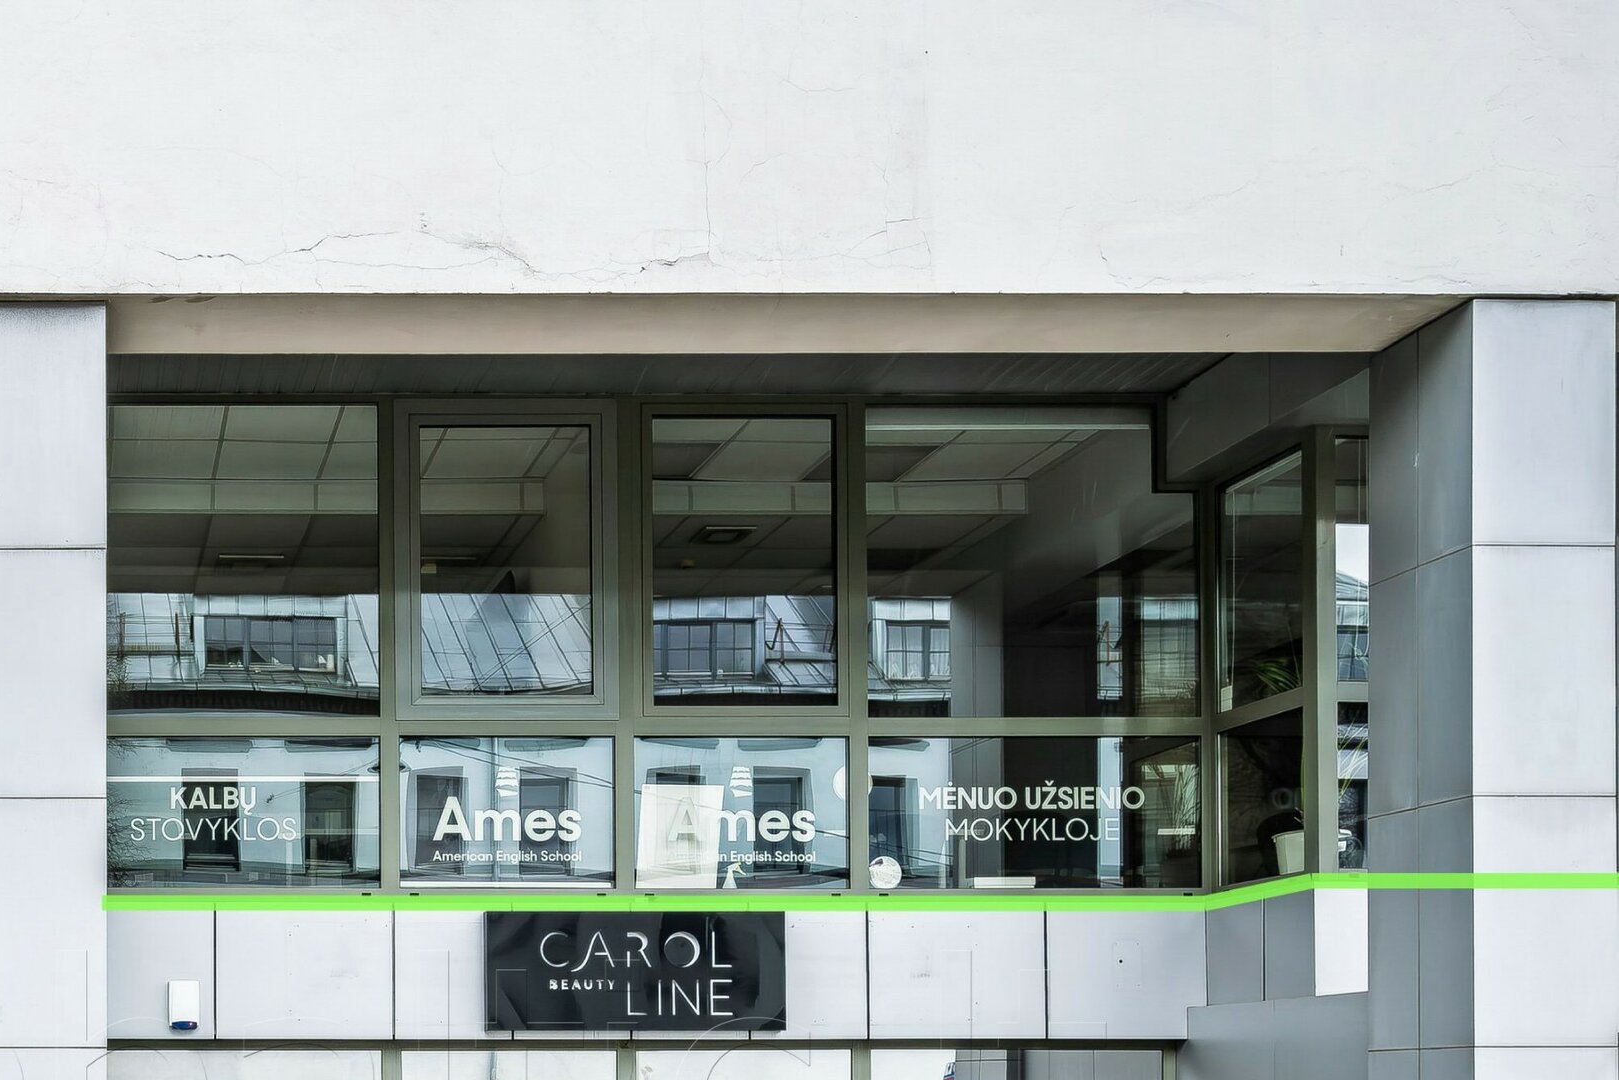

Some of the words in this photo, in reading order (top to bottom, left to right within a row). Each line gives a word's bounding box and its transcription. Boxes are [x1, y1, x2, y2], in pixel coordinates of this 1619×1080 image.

[169, 786, 257, 813] KALBŲ
[919, 782, 1019, 811] MĖNUO
[1024, 780, 1146, 811] UŽSIENIO
[129, 817, 298, 843] STOVYKLOS
[432, 796, 583, 843] Ames
[667, 796, 816, 843] Ames
[944, 817, 1121, 843] MOKYKLOJE
[432, 850, 494, 864] American
[495, 850, 539, 866] English
[540, 850, 583, 864] School
[730, 850, 772, 866] English
[774, 850, 816, 863] School
[539, 930, 734, 973] CAROL
[549, 979, 615, 991] BEAUTY
[627, 978, 734, 1016] LINE
